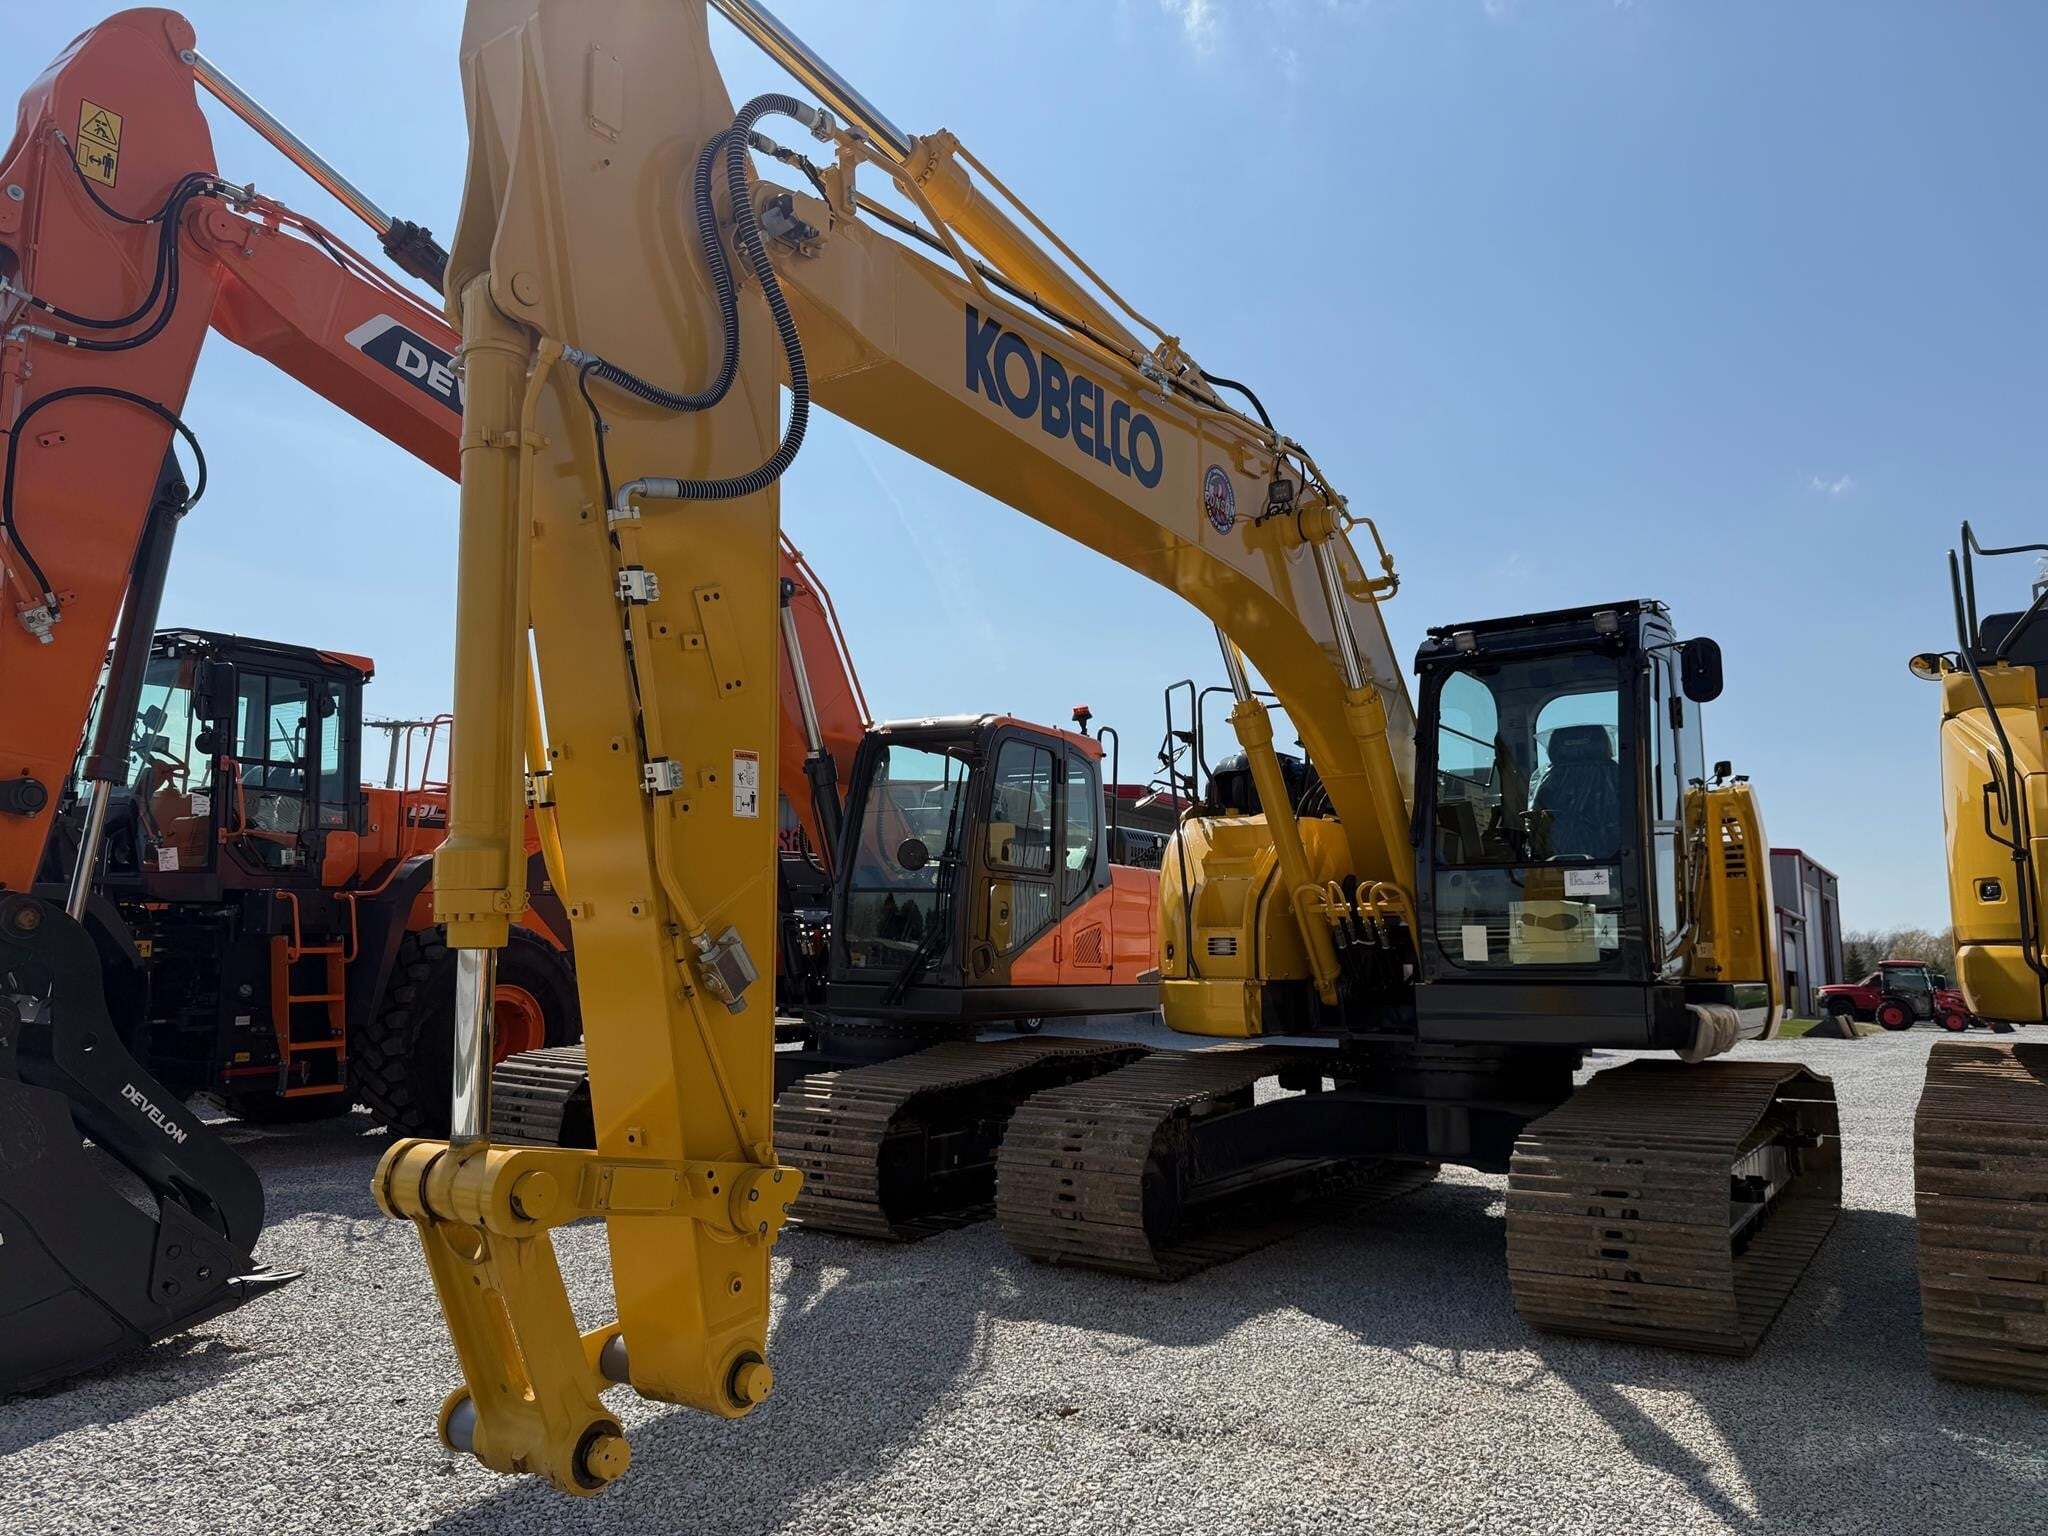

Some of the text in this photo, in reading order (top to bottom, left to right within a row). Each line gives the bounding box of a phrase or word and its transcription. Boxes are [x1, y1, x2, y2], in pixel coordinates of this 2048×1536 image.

[395, 340, 463, 406] DE
[965, 302, 1163, 489] KOBELCO
[120, 1083, 188, 1144] DEVELON
